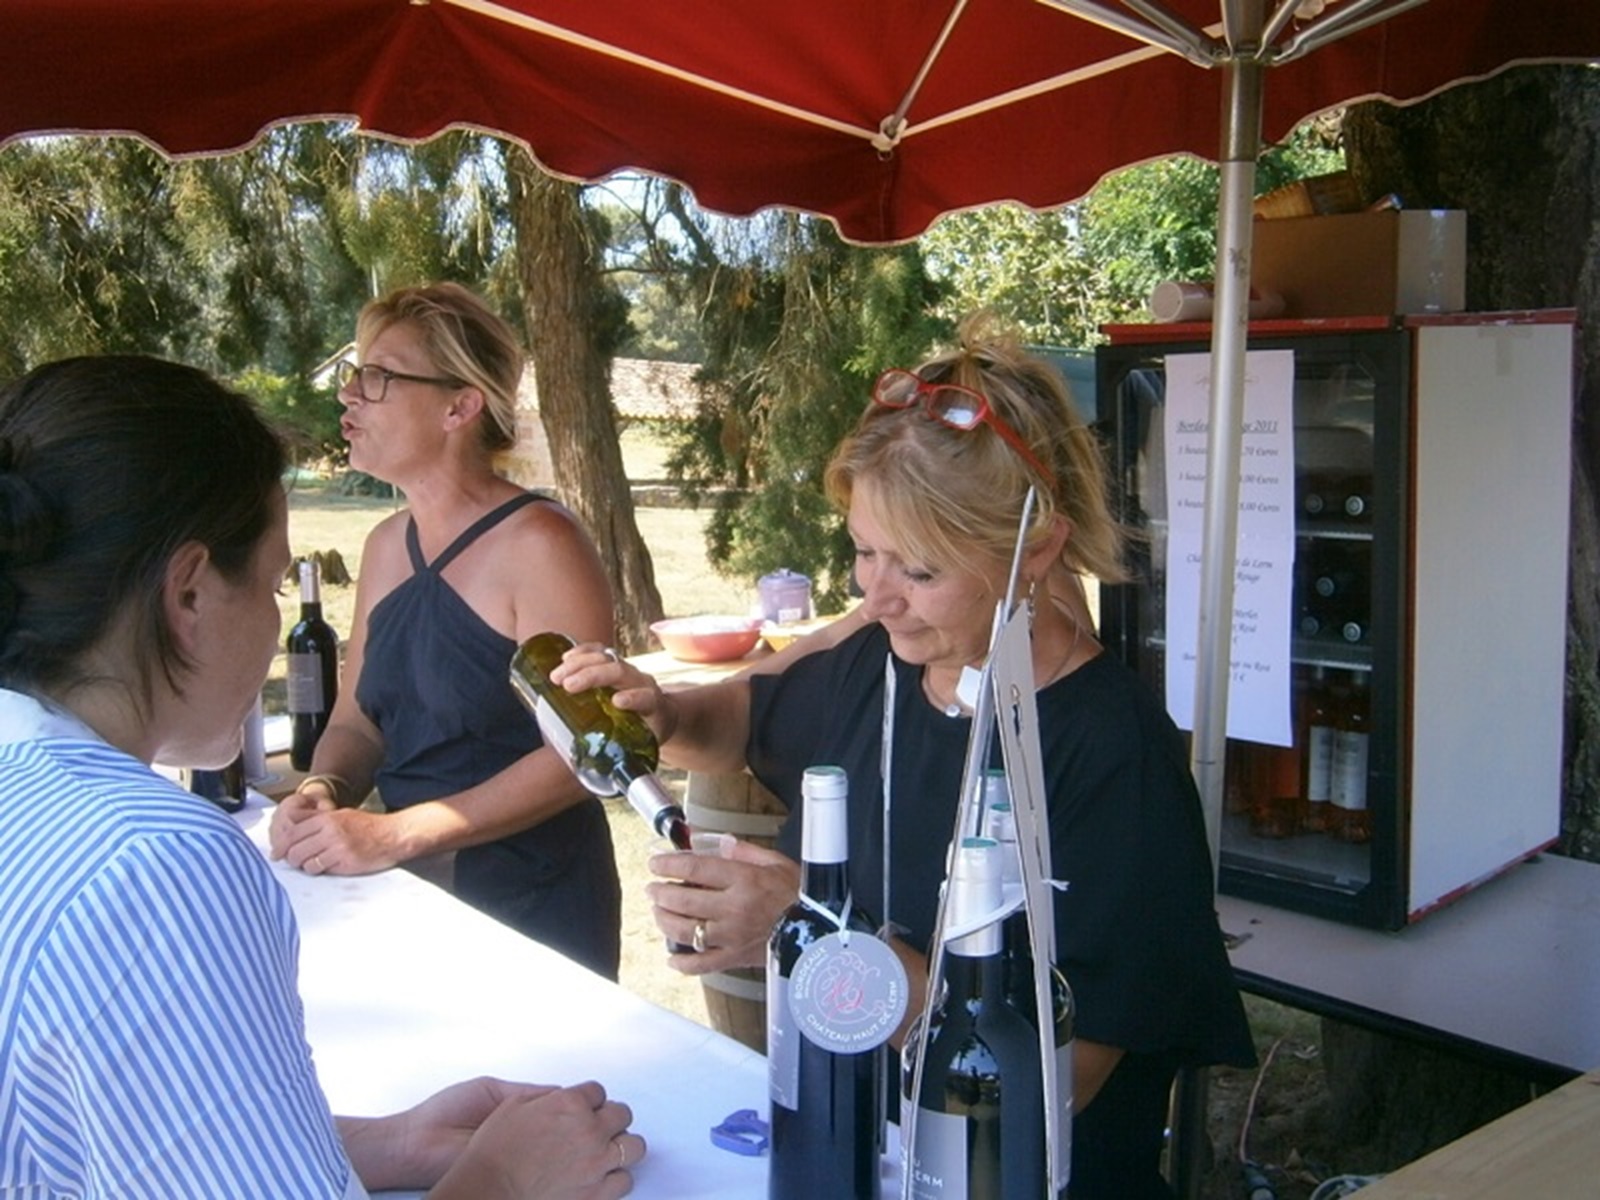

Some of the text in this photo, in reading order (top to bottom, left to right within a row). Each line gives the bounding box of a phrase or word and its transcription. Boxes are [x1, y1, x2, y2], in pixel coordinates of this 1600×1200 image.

[795, 946, 827, 999] BORDEAUX
[852, 1024, 880, 1041] HAUT
[879, 1012, 893, 1025] DE
[888, 981, 898, 1010] LERM
